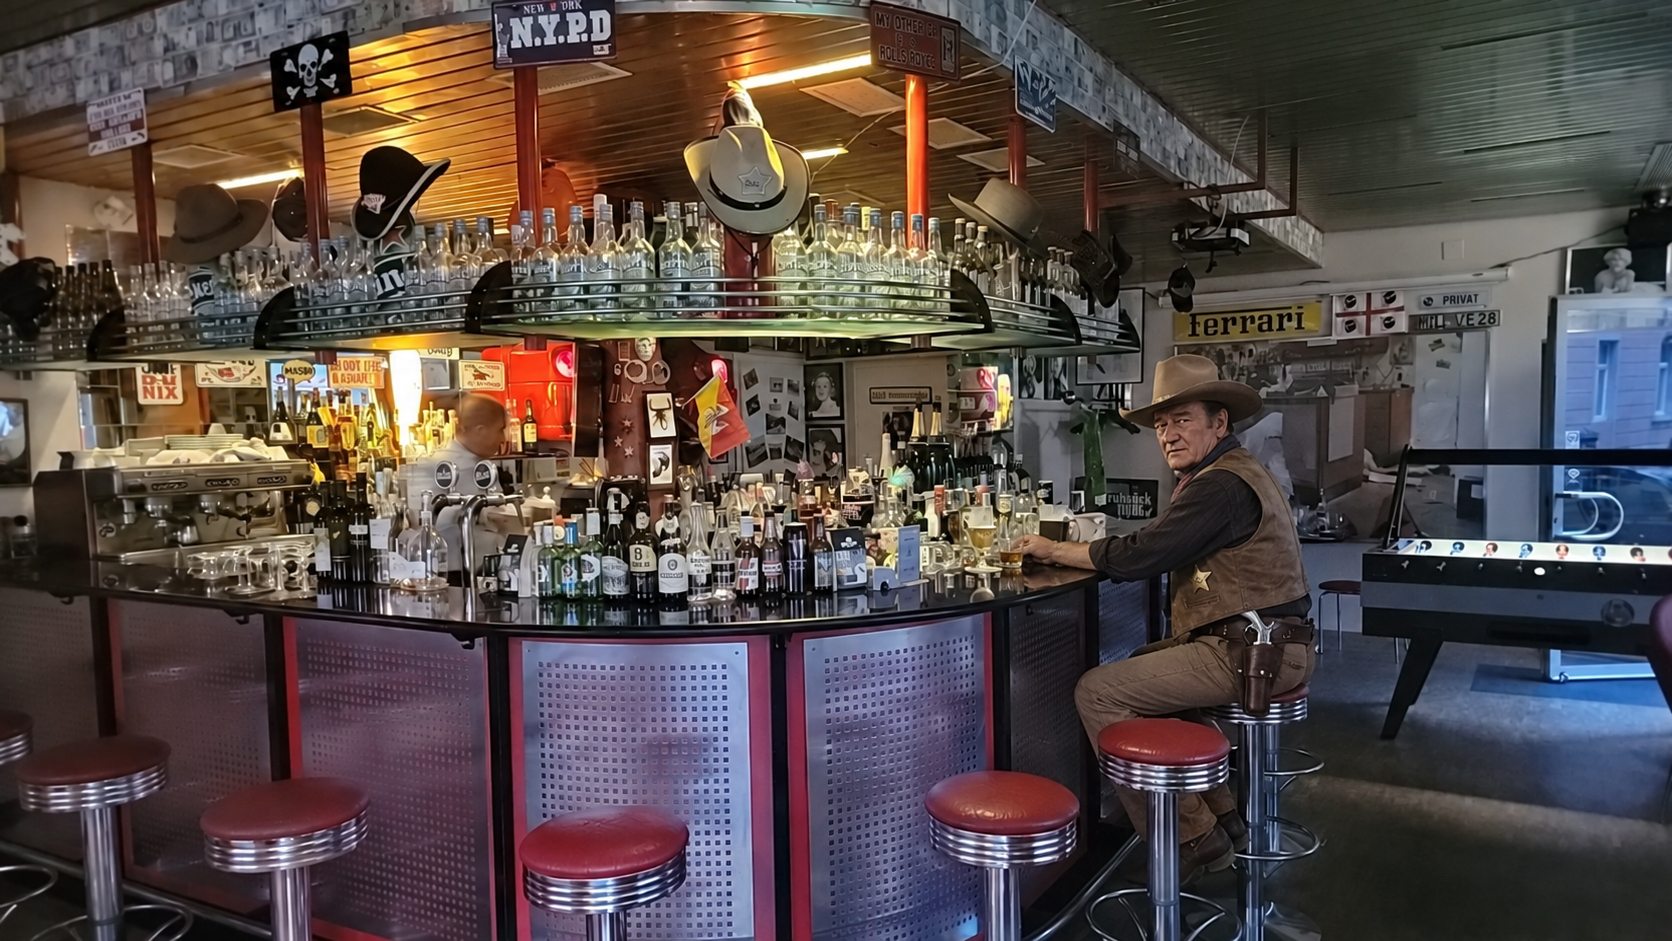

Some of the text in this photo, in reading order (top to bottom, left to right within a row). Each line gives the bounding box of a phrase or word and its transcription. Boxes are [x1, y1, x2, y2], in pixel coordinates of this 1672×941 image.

[523, 4, 545, 15] NEW
[510, 10, 612, 49] N.Y.P.D
[875, 11, 891, 28] MY
[894, 14, 925, 36] OTHER
[879, 44, 908, 65] ROLLS
[1442, 293, 1480, 306] PRIVAT
[1477, 311, 1497, 326] 28
[142, 385, 179, 400] NIX
